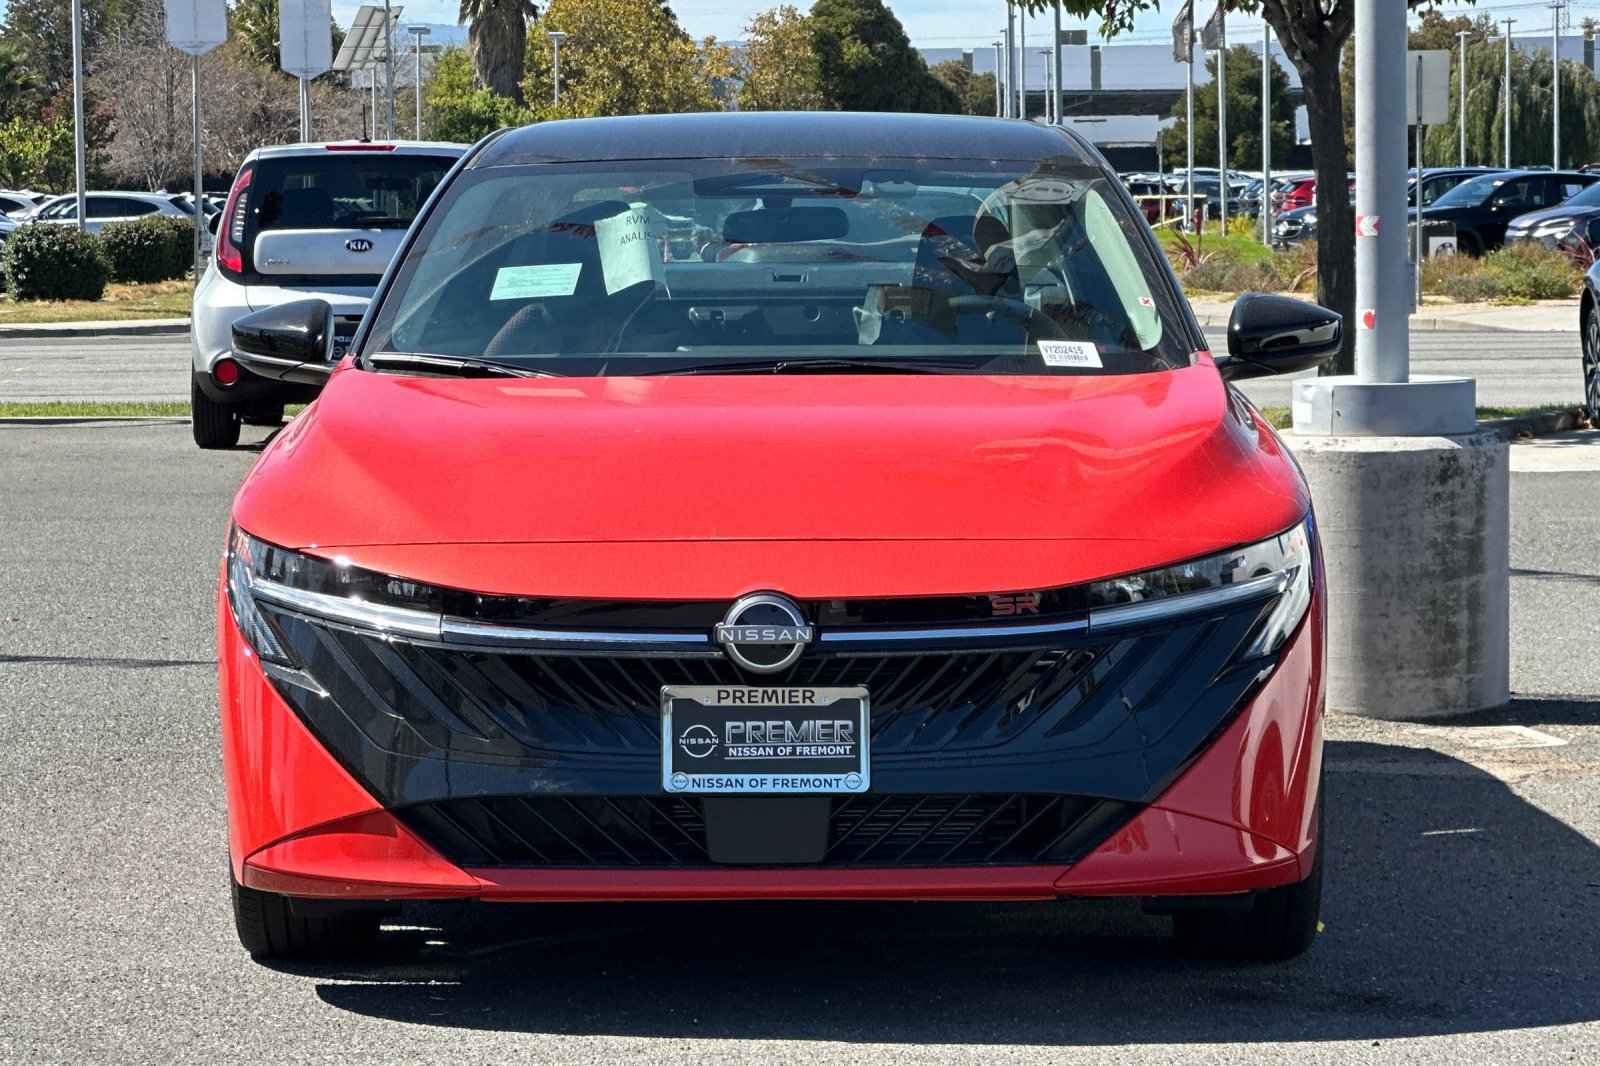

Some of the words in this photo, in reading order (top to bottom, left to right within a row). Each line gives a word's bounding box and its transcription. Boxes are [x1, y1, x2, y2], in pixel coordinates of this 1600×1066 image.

[626, 215, 650, 226] RVM
[350, 241, 370, 250] KIA
[1042, 345, 1084, 355] VY202415
[991, 595, 1039, 616] SR
[720, 628, 810, 641] NISSAN
[716, 689, 816, 704] PREMIER
[724, 719, 856, 744] PREMIER
[679, 737, 719, 745] NISSAN
[728, 746, 774, 757] NISSAN
[777, 746, 793, 756] OF
[796, 745, 852, 756] FREMONT
[691, 778, 745, 789] NISSAN
[749, 778, 769, 788] OF
[772, 777, 843, 788] FREMONT
